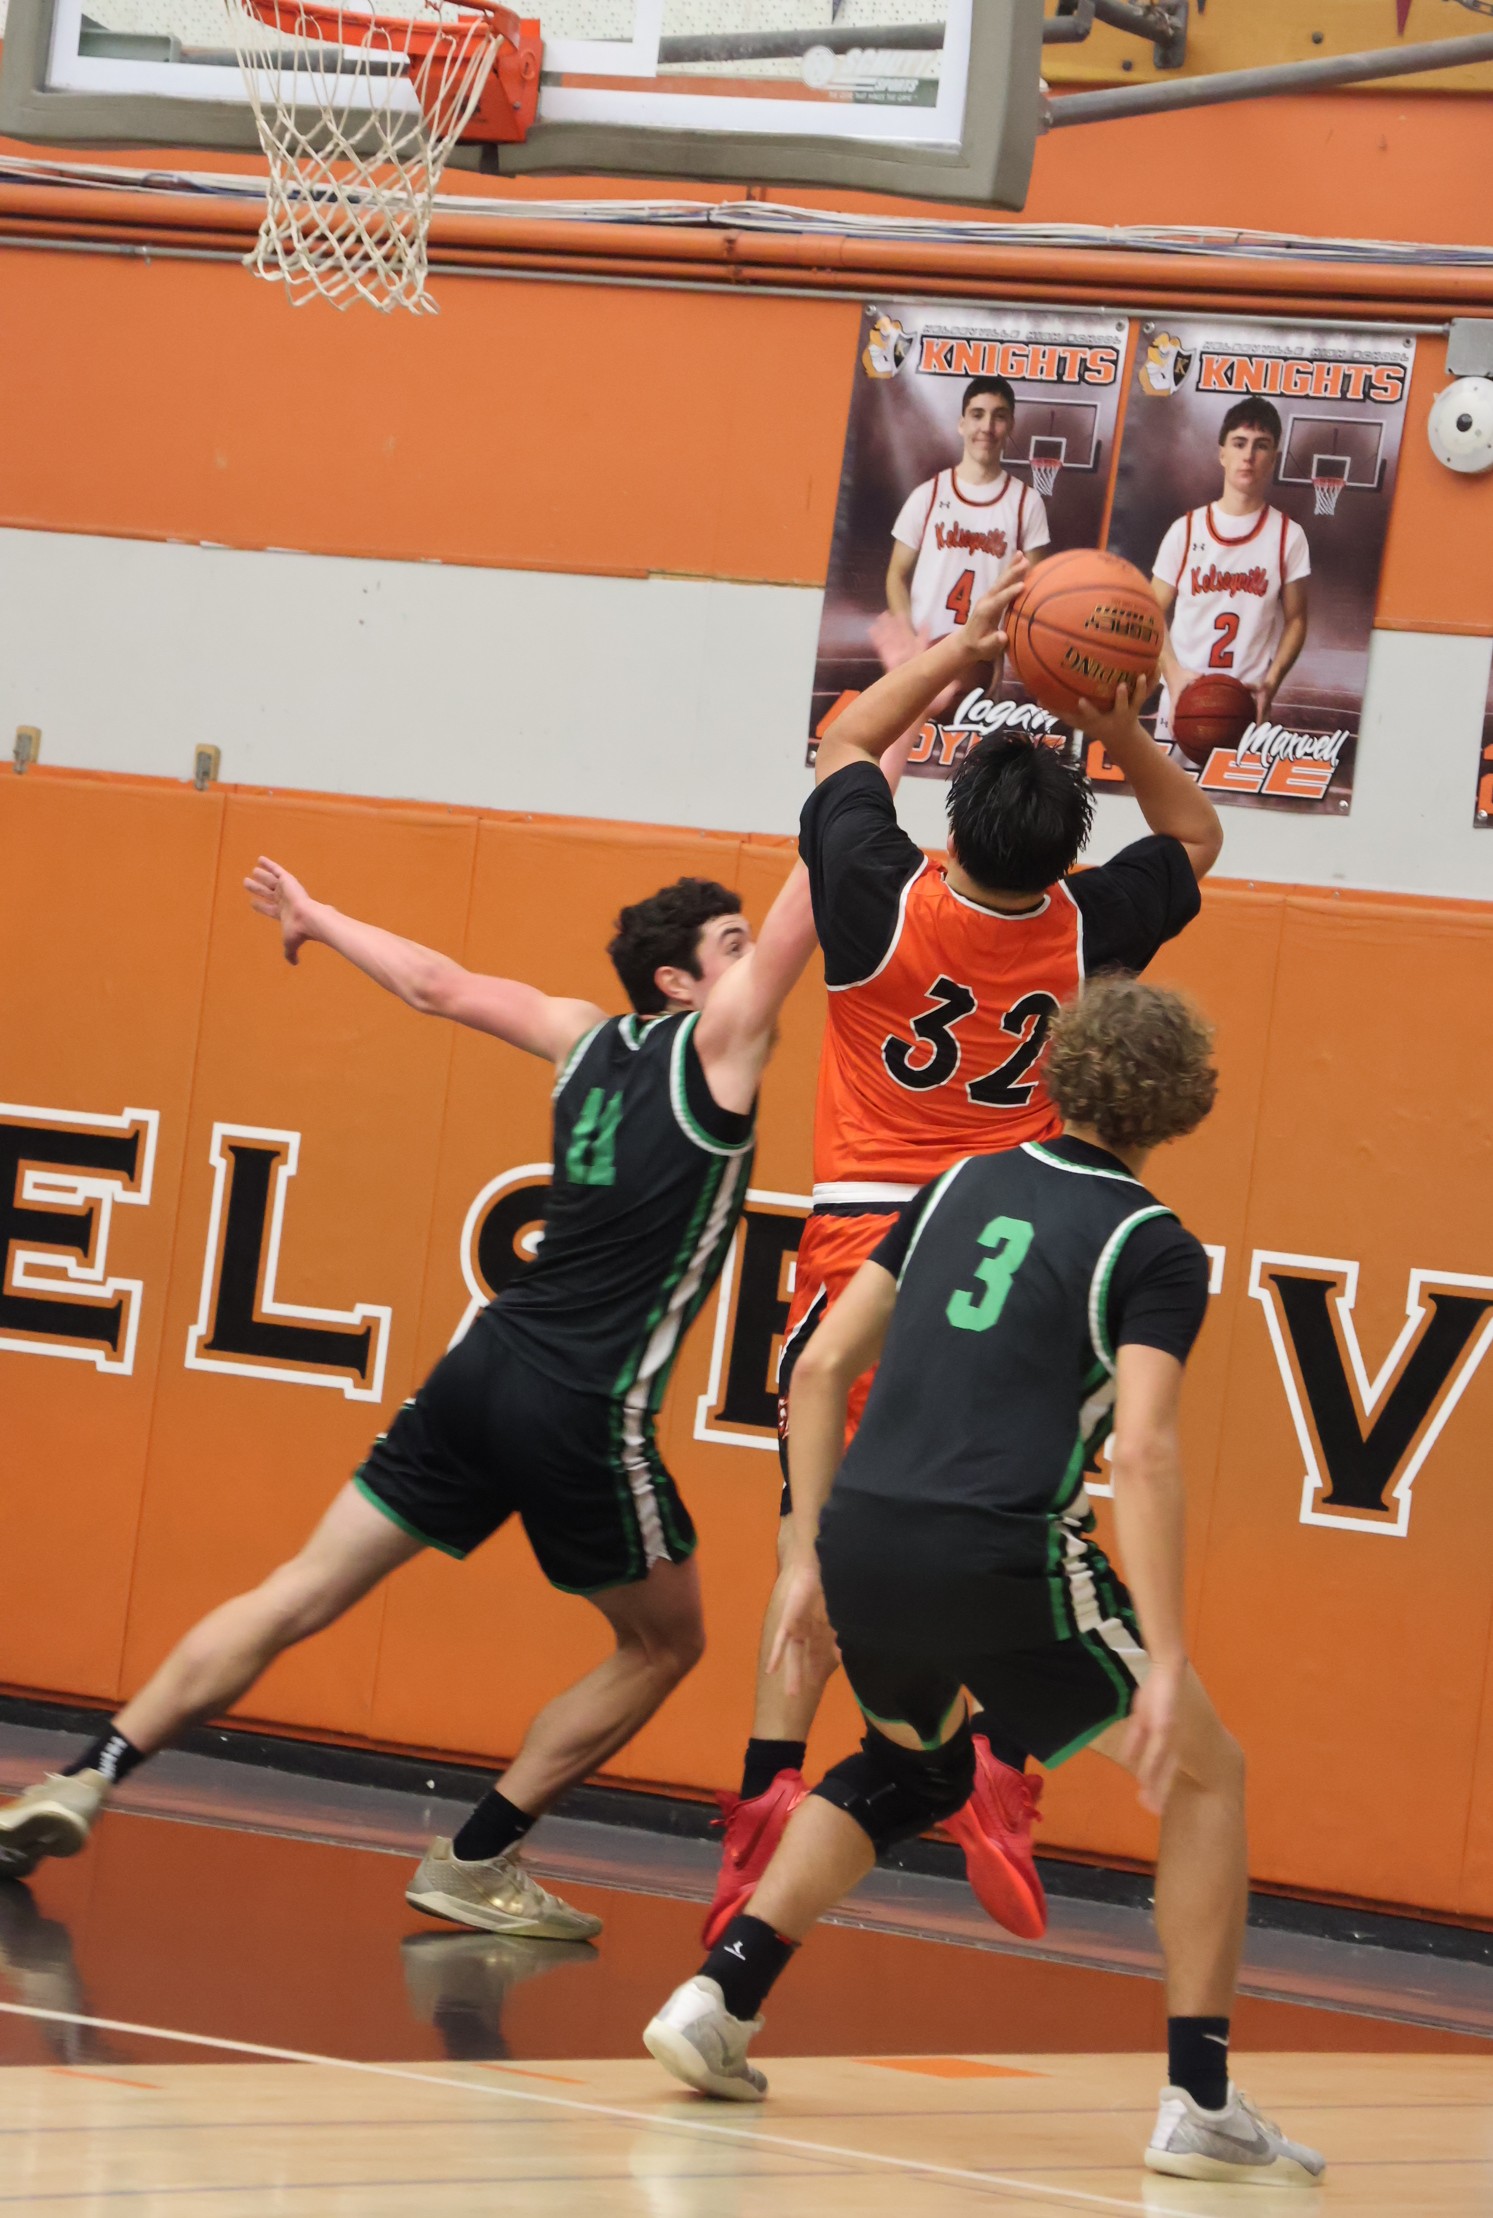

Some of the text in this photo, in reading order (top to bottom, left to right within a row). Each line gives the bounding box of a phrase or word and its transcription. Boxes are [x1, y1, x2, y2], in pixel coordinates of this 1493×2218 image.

[918, 336, 1119, 386] KNIGHTS
[1198, 353, 1406, 404] KNIGHTS
[946, 569, 976, 625] 4
[1208, 611, 1240, 669] 2
[943, 687, 1060, 737] Logan
[1157, 741, 1338, 799] EE
[1236, 721, 1350, 768] Maxwell
[882, 974, 1061, 1107] 32
[946, 1216, 1034, 1332] 3
